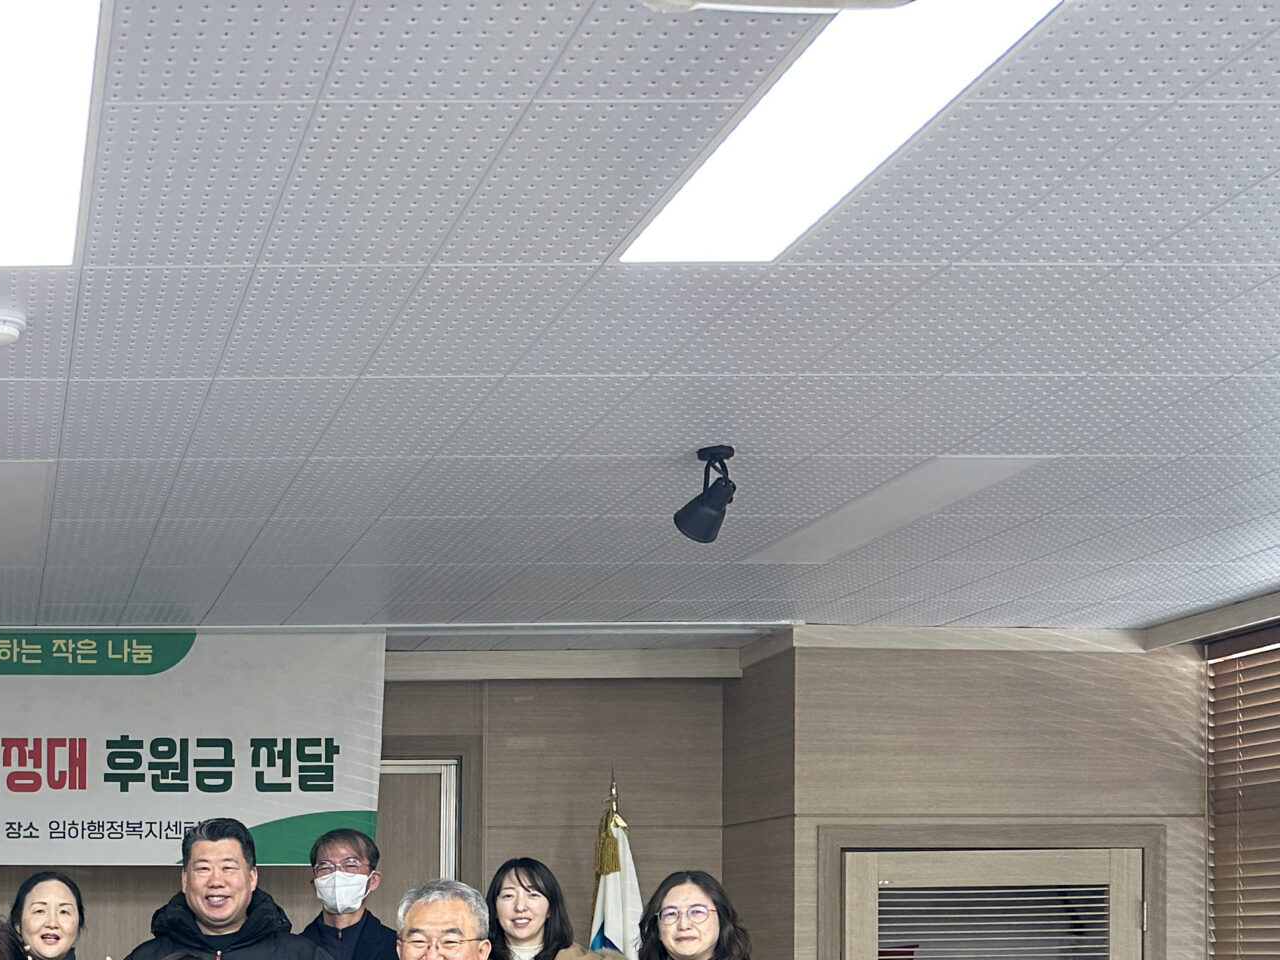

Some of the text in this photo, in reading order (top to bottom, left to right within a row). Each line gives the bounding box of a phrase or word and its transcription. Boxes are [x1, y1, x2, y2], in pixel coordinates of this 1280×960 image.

[52, 638, 98, 664] 작은
[107, 638, 153, 664] 나눔
[103, 734, 236, 793] 후원금
[250, 737, 341, 793] 전달
[5, 821, 40, 839] 장소
